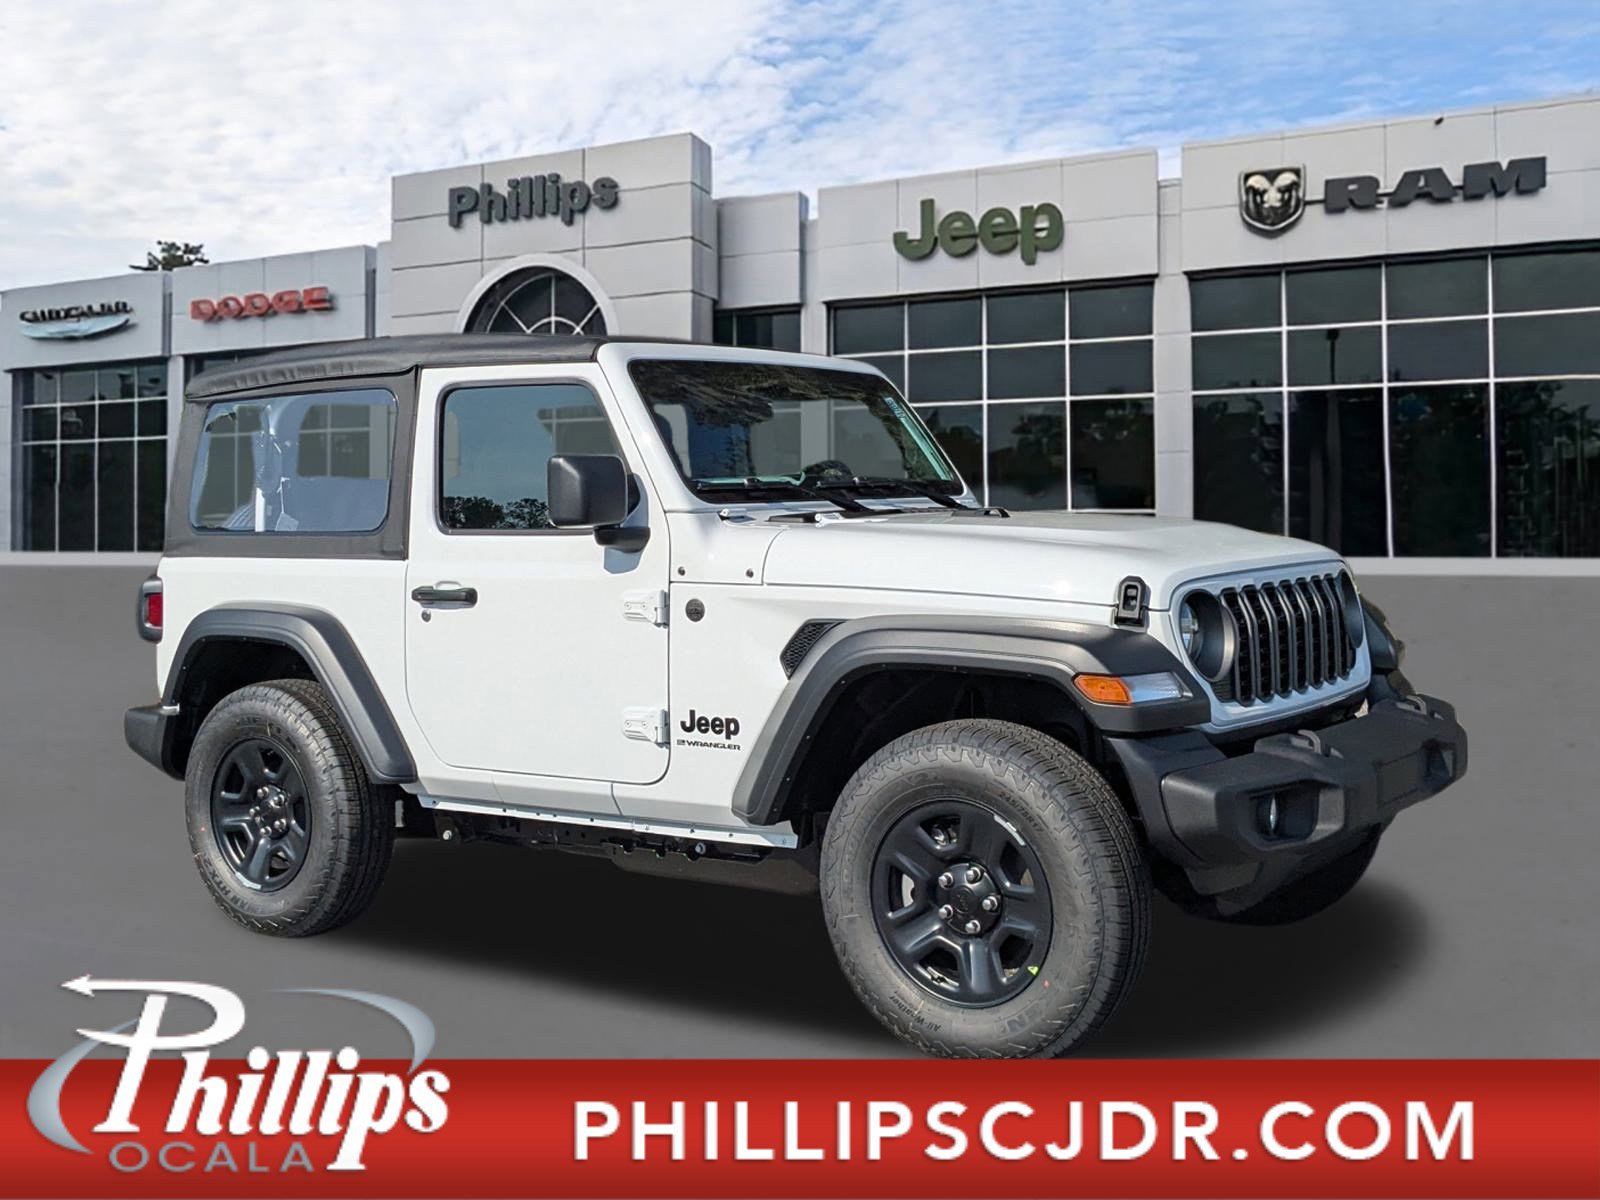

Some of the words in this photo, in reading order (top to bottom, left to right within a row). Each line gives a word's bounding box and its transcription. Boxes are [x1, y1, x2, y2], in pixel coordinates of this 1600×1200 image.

[448, 172, 620, 229] Phillips
[1324, 156, 1547, 214] RAM
[893, 198, 1065, 266] Jeep
[190, 286, 334, 322] DODGE
[680, 709, 740, 740] Jeep
[686, 739, 741, 751] WRANGLER
